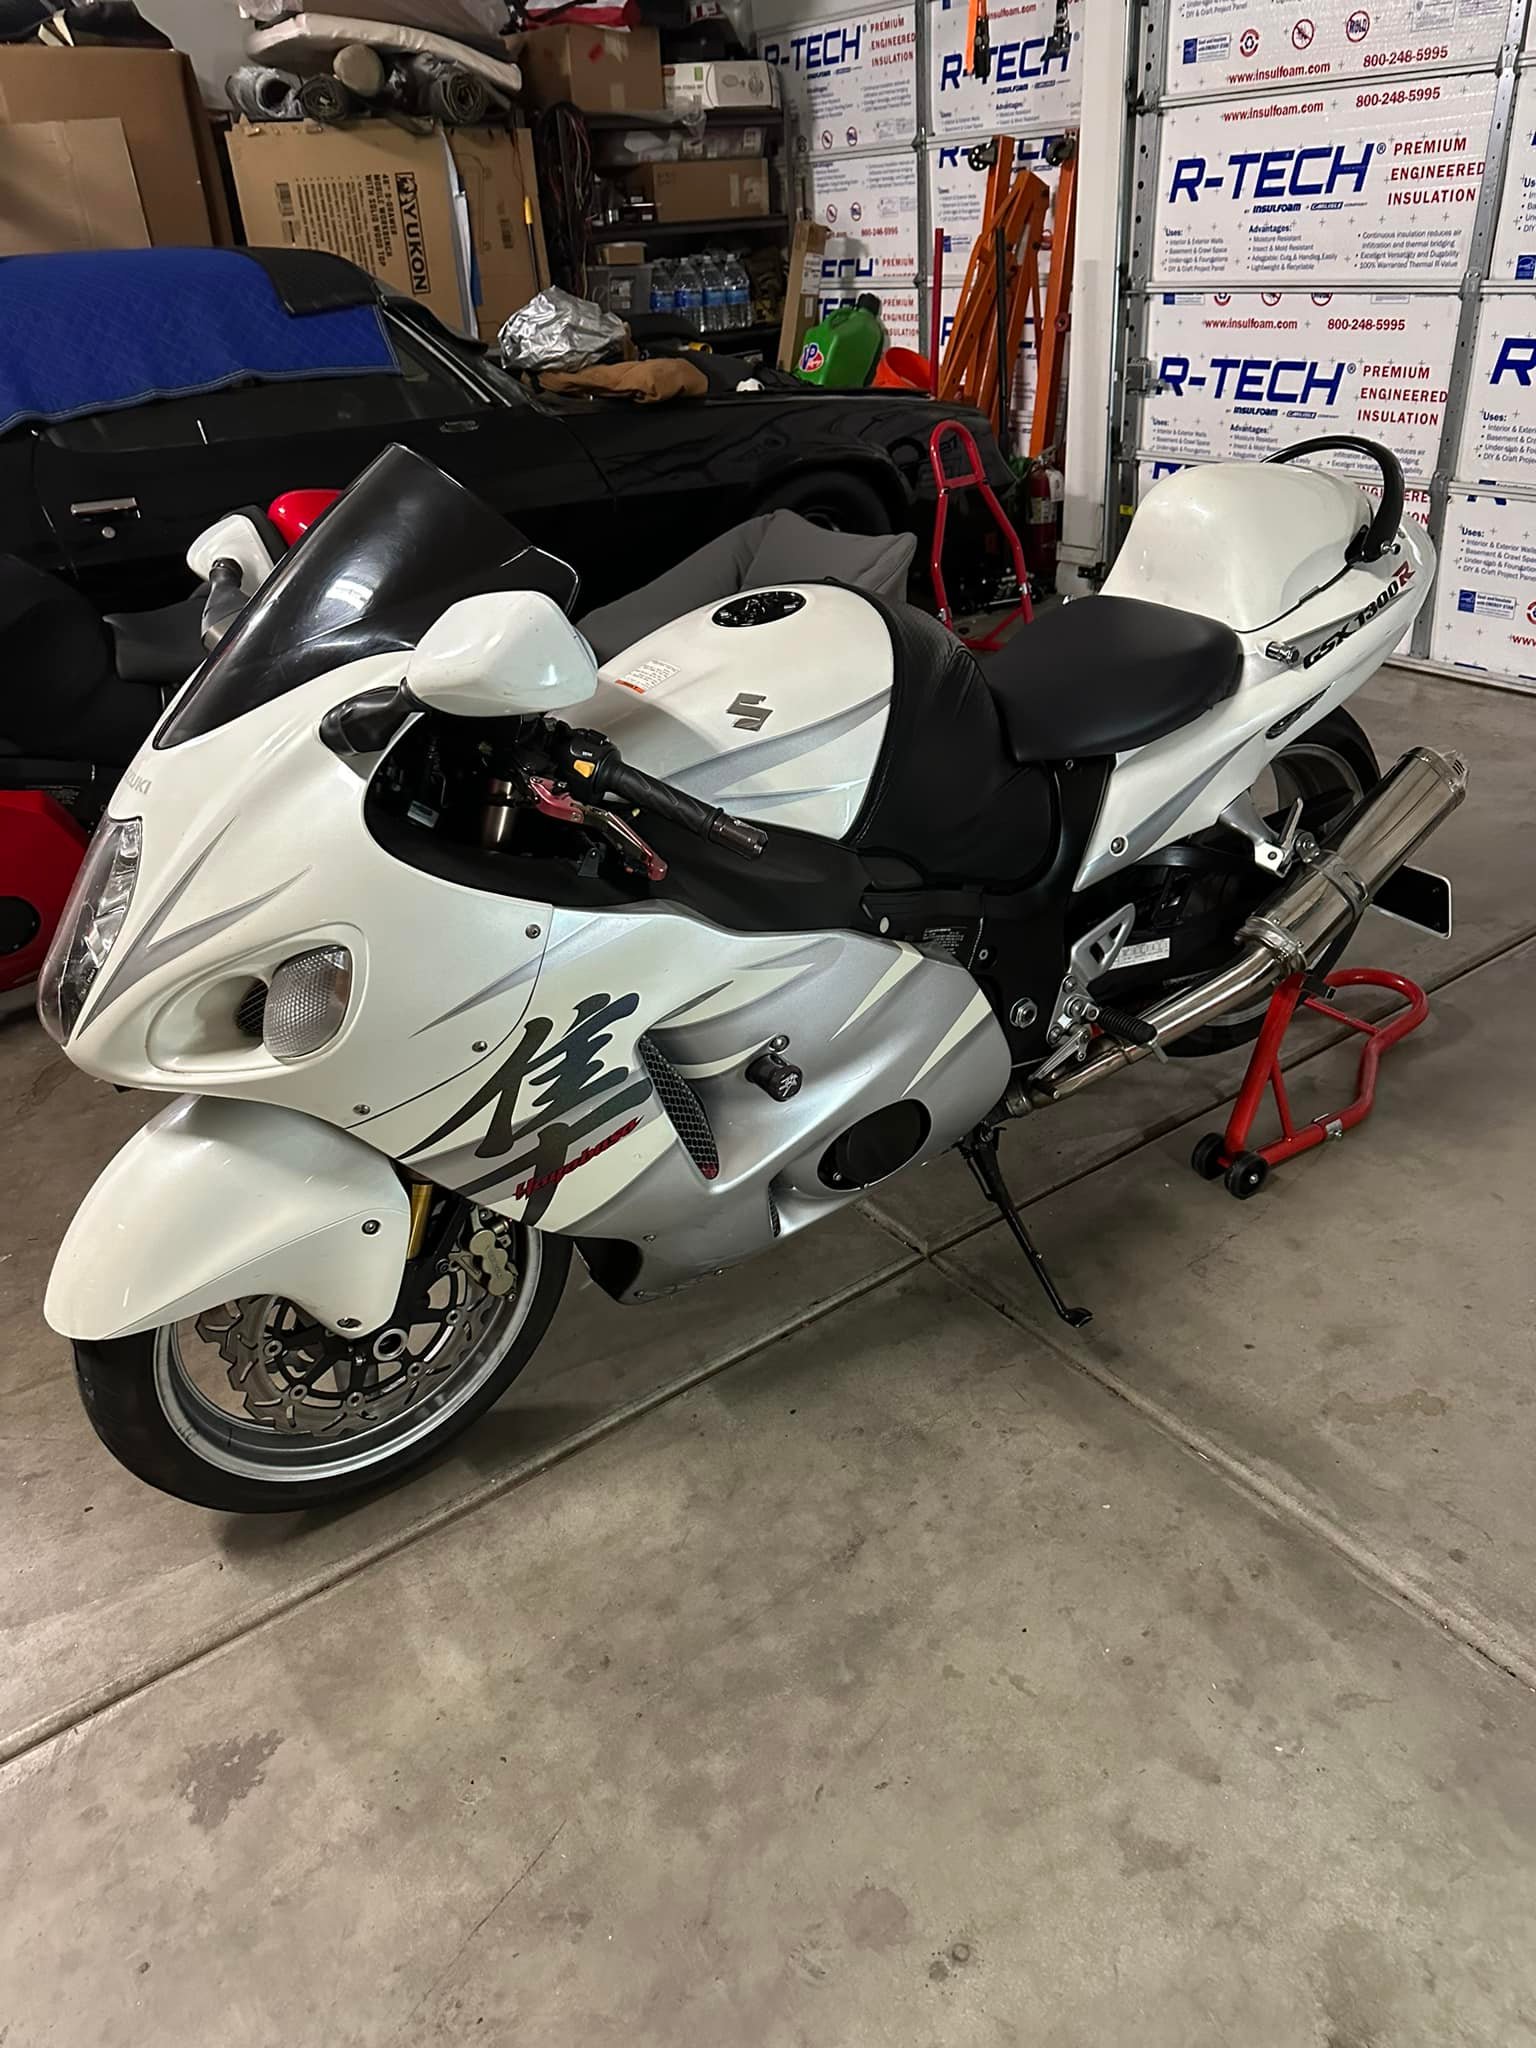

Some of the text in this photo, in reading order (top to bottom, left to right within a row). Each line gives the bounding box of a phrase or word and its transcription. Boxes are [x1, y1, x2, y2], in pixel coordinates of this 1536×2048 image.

[871, 17, 904, 33] PREMIUM
[871, 32, 916, 50] ENGINEERED
[872, 51, 913, 67] INSULATION
[1228, 46, 1448, 84] www.insulfoam.com 800-248-5995
[1223, 87, 1441, 122] www.insulfoam.com 800-248-5995
[1394, 137, 1466, 156] PREMIUM
[1169, 143, 1375, 203] R-TECH
[1391, 162, 1485, 181] ENGINEERED
[1388, 188, 1476, 206] INSULATION
[404, 202, 427, 290] YUKON
[1204, 318, 1406, 331] www.insulfoam.com 800-248-5995
[1363, 365, 1430, 379] PREMIUM
[1155, 357, 1346, 406] R-TECH
[1360, 387, 1448, 403] ENGINEERED
[1357, 409, 1439, 425] INSULATION
[1483, 411, 1507, 422] Uses:
[1462, 527, 1485, 537] Uses:
